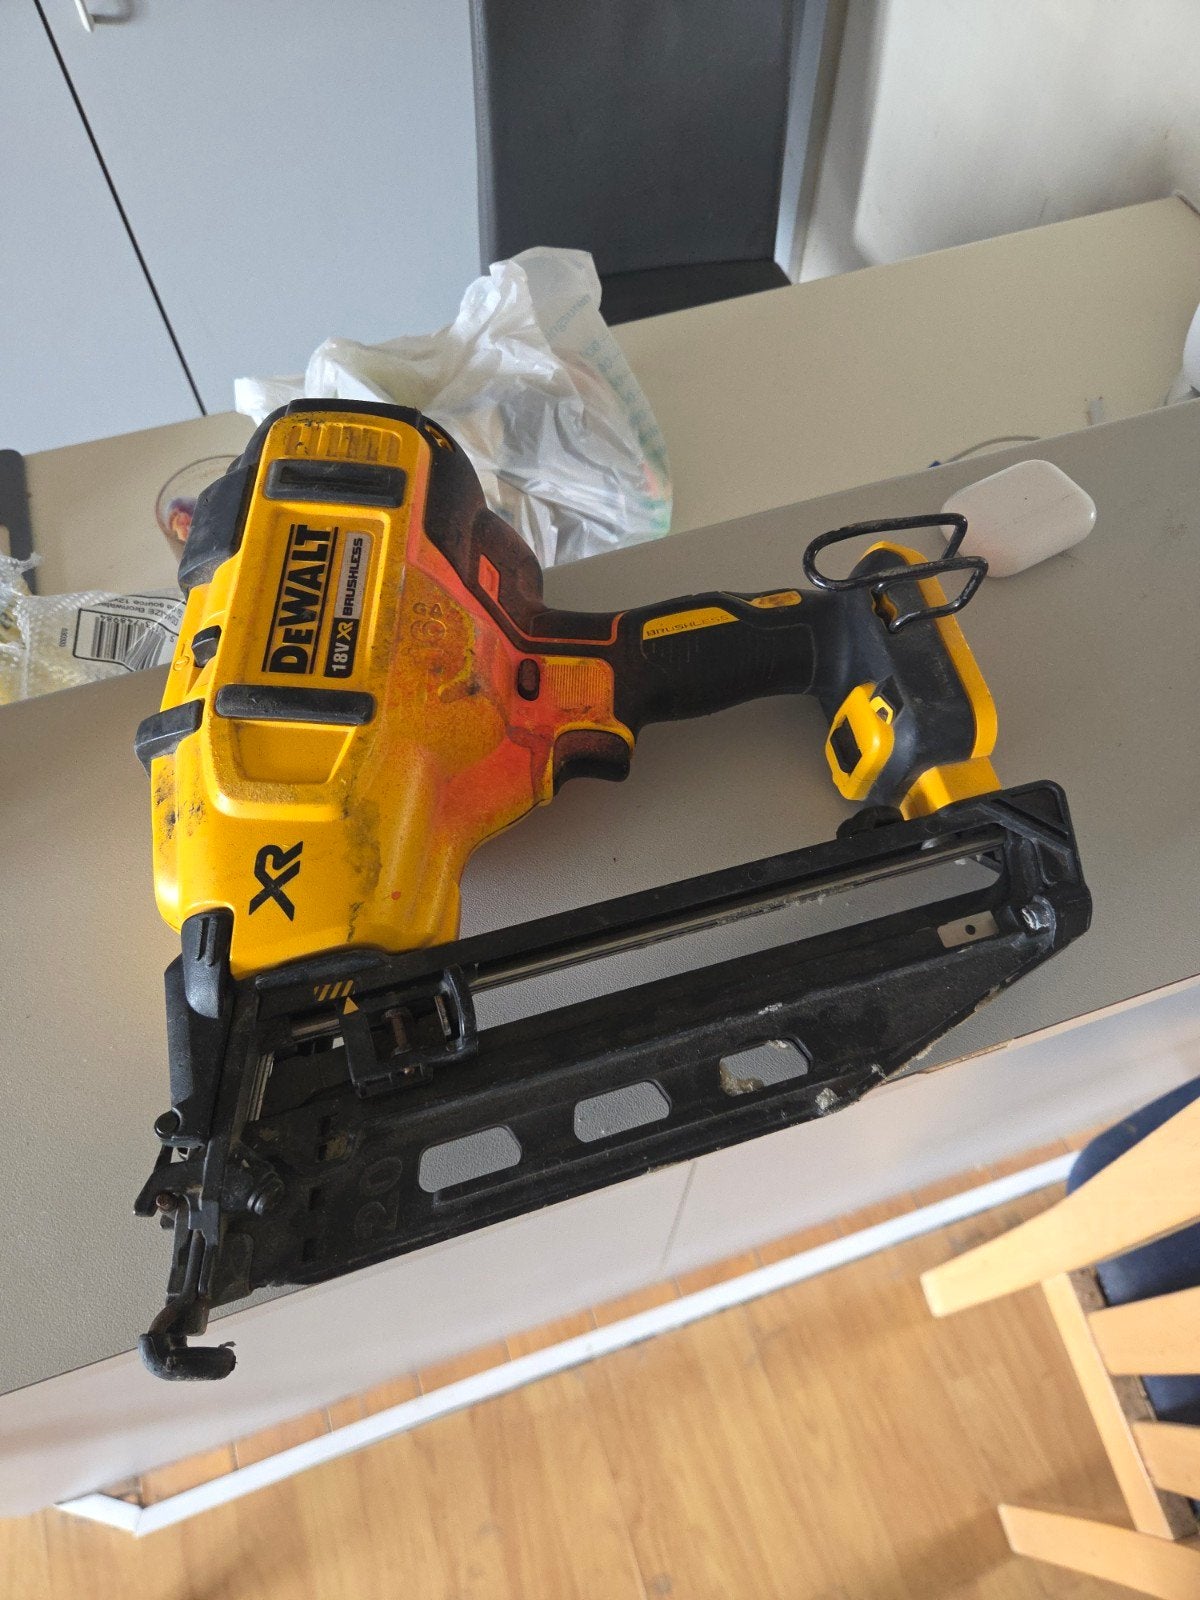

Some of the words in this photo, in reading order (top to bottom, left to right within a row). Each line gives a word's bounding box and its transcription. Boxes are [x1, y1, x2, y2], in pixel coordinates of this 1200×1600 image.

[269, 524, 332, 675] DEWALT
[331, 642, 350, 672] 18V
[342, 537, 364, 617] BRUSHLESS
[646, 615, 730, 637] BRUSHLESS
[248, 840, 304, 922] XR
